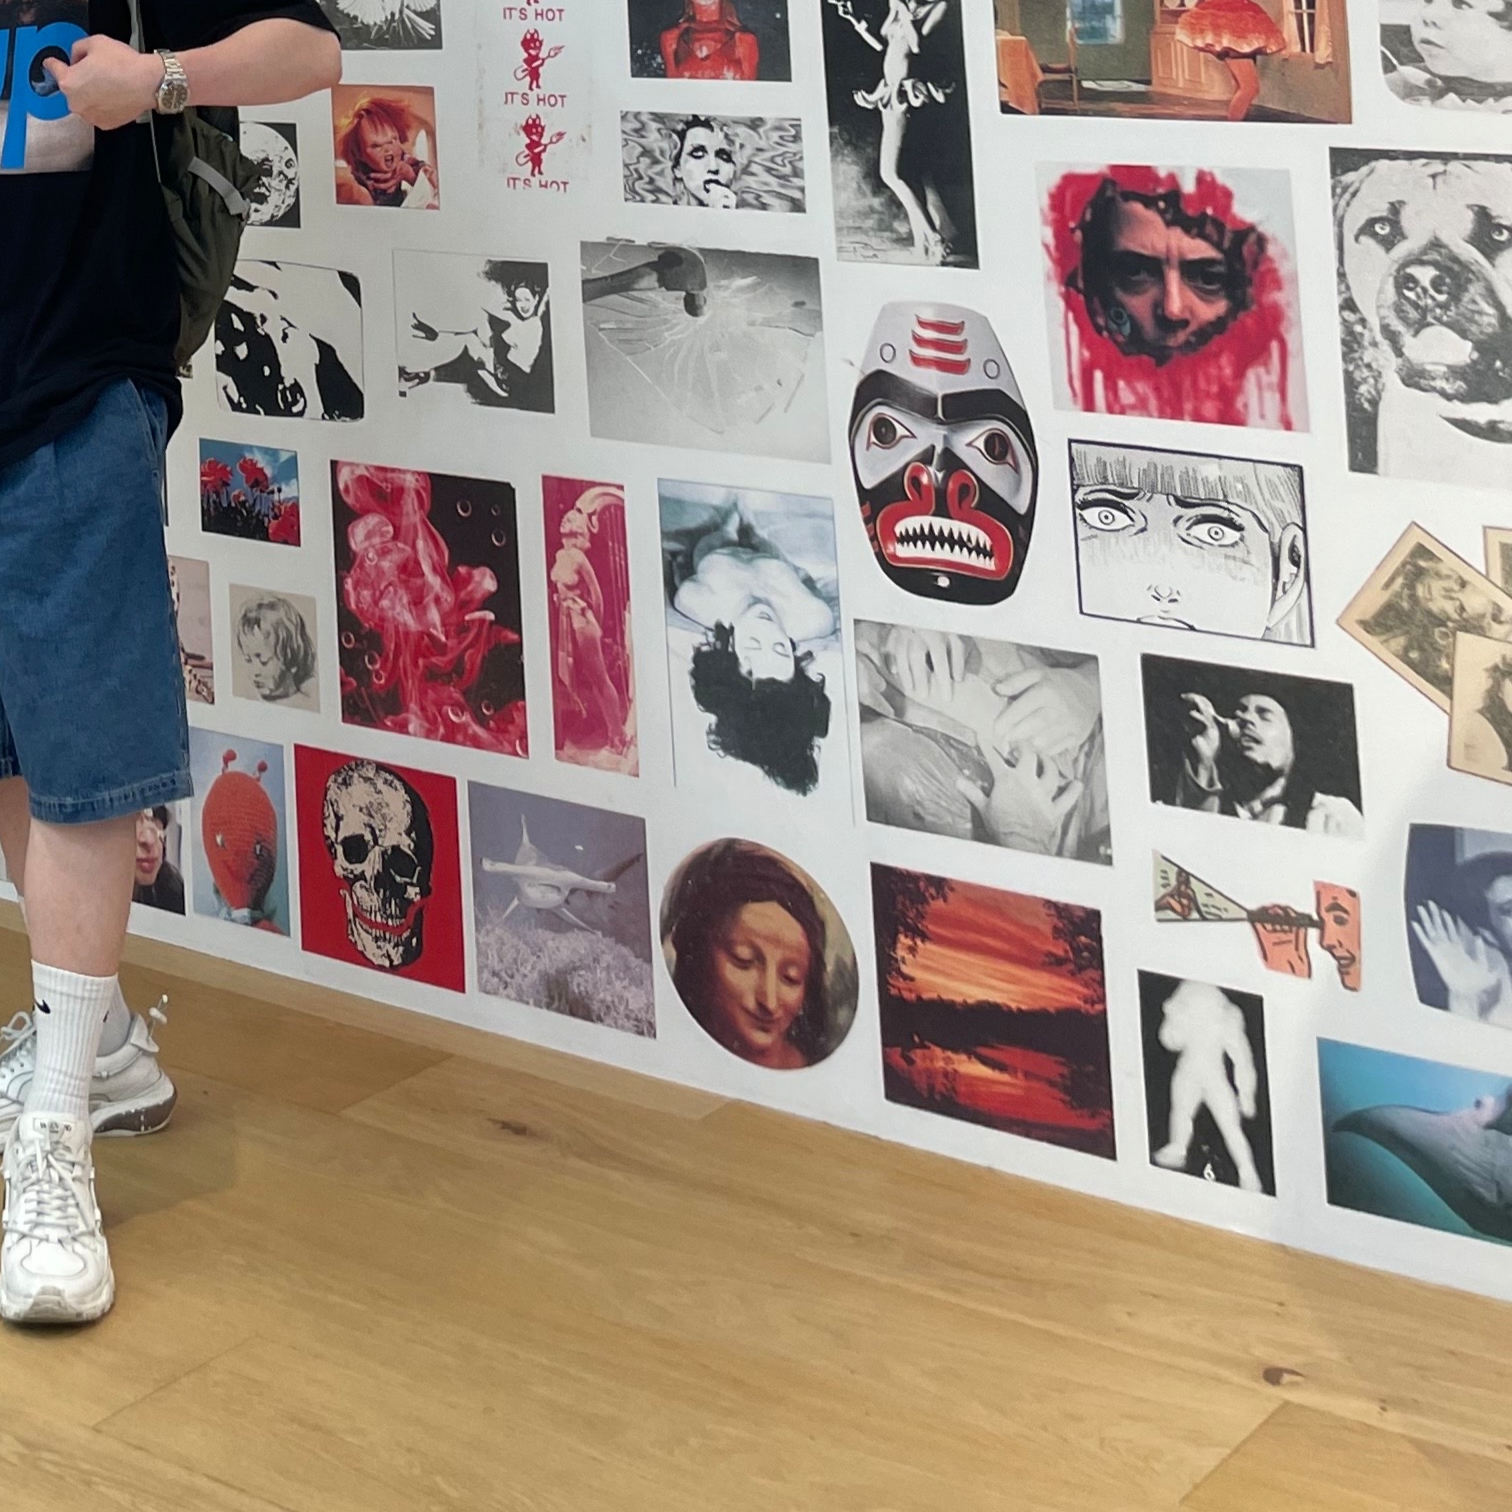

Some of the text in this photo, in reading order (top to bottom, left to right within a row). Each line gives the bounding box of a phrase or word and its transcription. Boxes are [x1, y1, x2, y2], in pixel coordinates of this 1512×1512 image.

[503, 7, 565, 22] IT'S HOT
[504, 92, 567, 108] IT'S HOT
[539, 179, 569, 193] HOT
